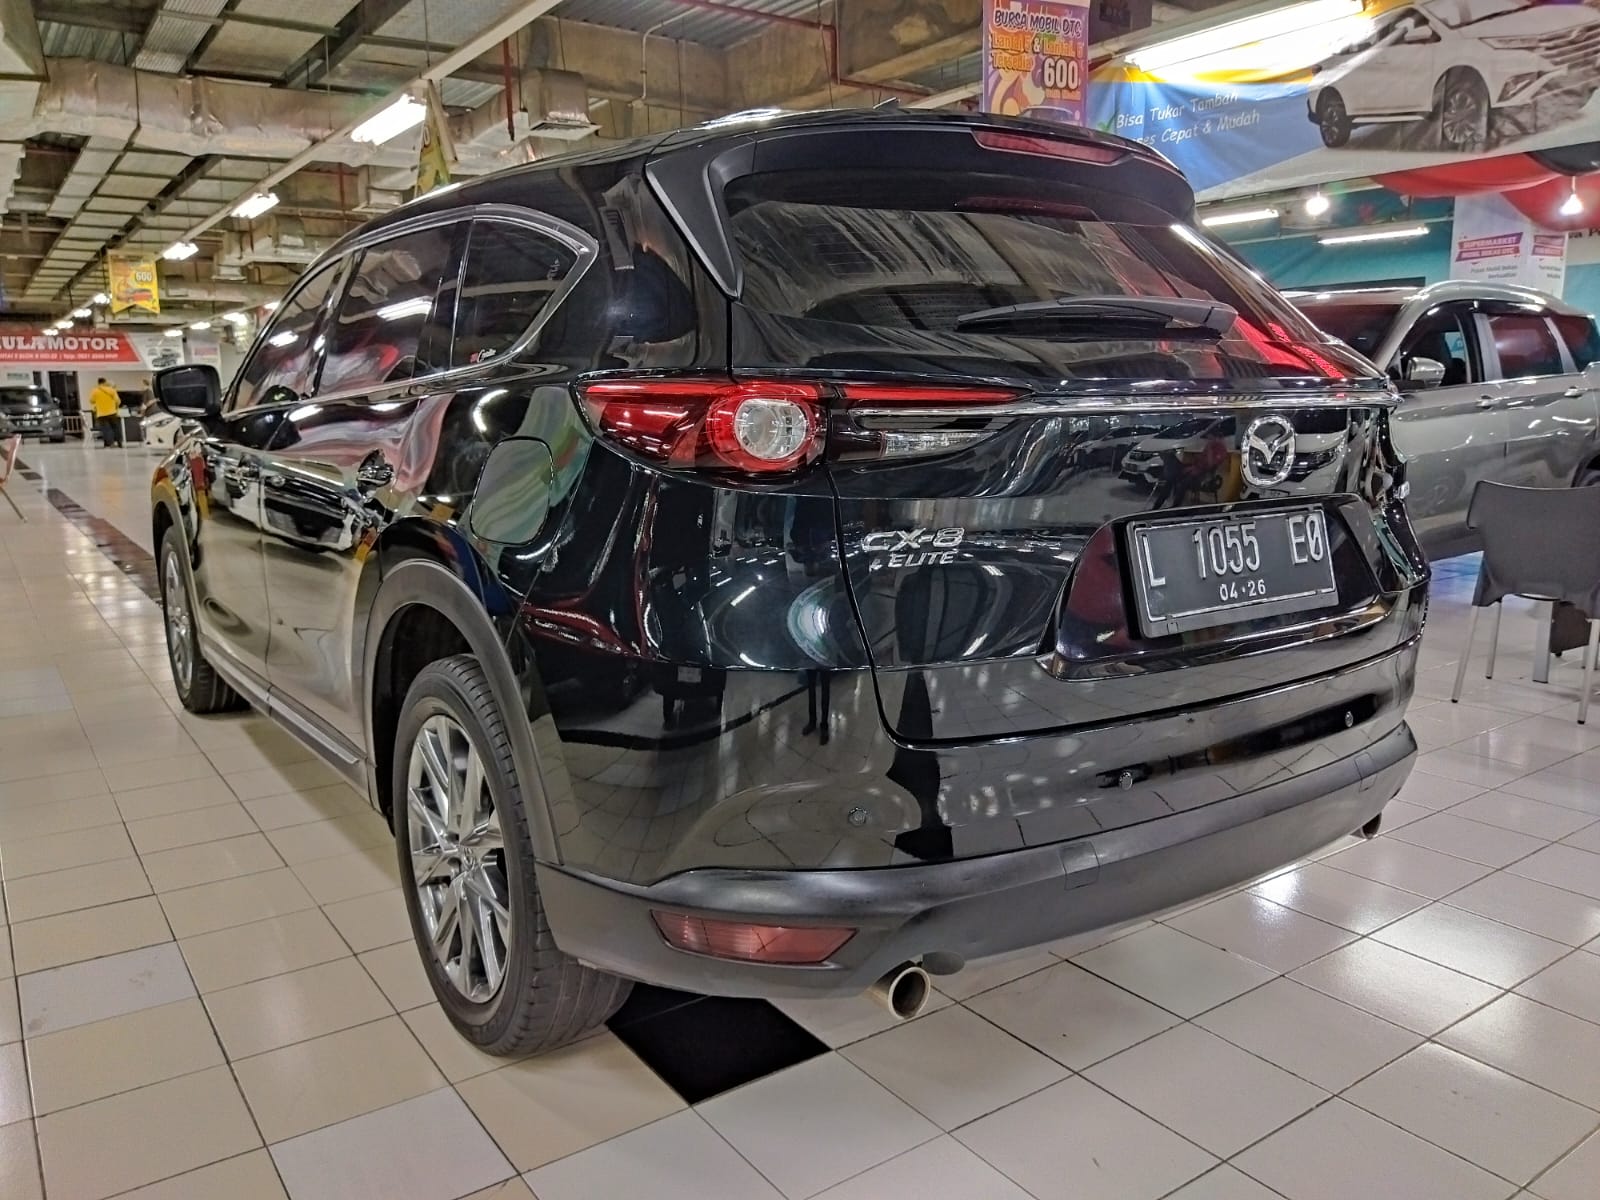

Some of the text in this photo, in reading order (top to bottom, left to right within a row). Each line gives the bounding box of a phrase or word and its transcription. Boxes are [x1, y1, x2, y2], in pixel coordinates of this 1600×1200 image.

[995, 9, 1082, 37] BURSA MOBIL DTC
[1032, 37, 1041, 54] &
[1043, 57, 1079, 90] 600
[1116, 92, 1239, 129] Bisa Tukar Tambah
[1161, 124, 1199, 144] Cepat
[1202, 120, 1212, 134] &
[1216, 109, 1261, 132] Mudah
[47, 336, 120, 351] MOTOR
[862, 527, 964, 552] CX-8
[888, 549, 959, 568] ELITE
[1141, 533, 1166, 587] L
[1192, 521, 1261, 579] 1055
